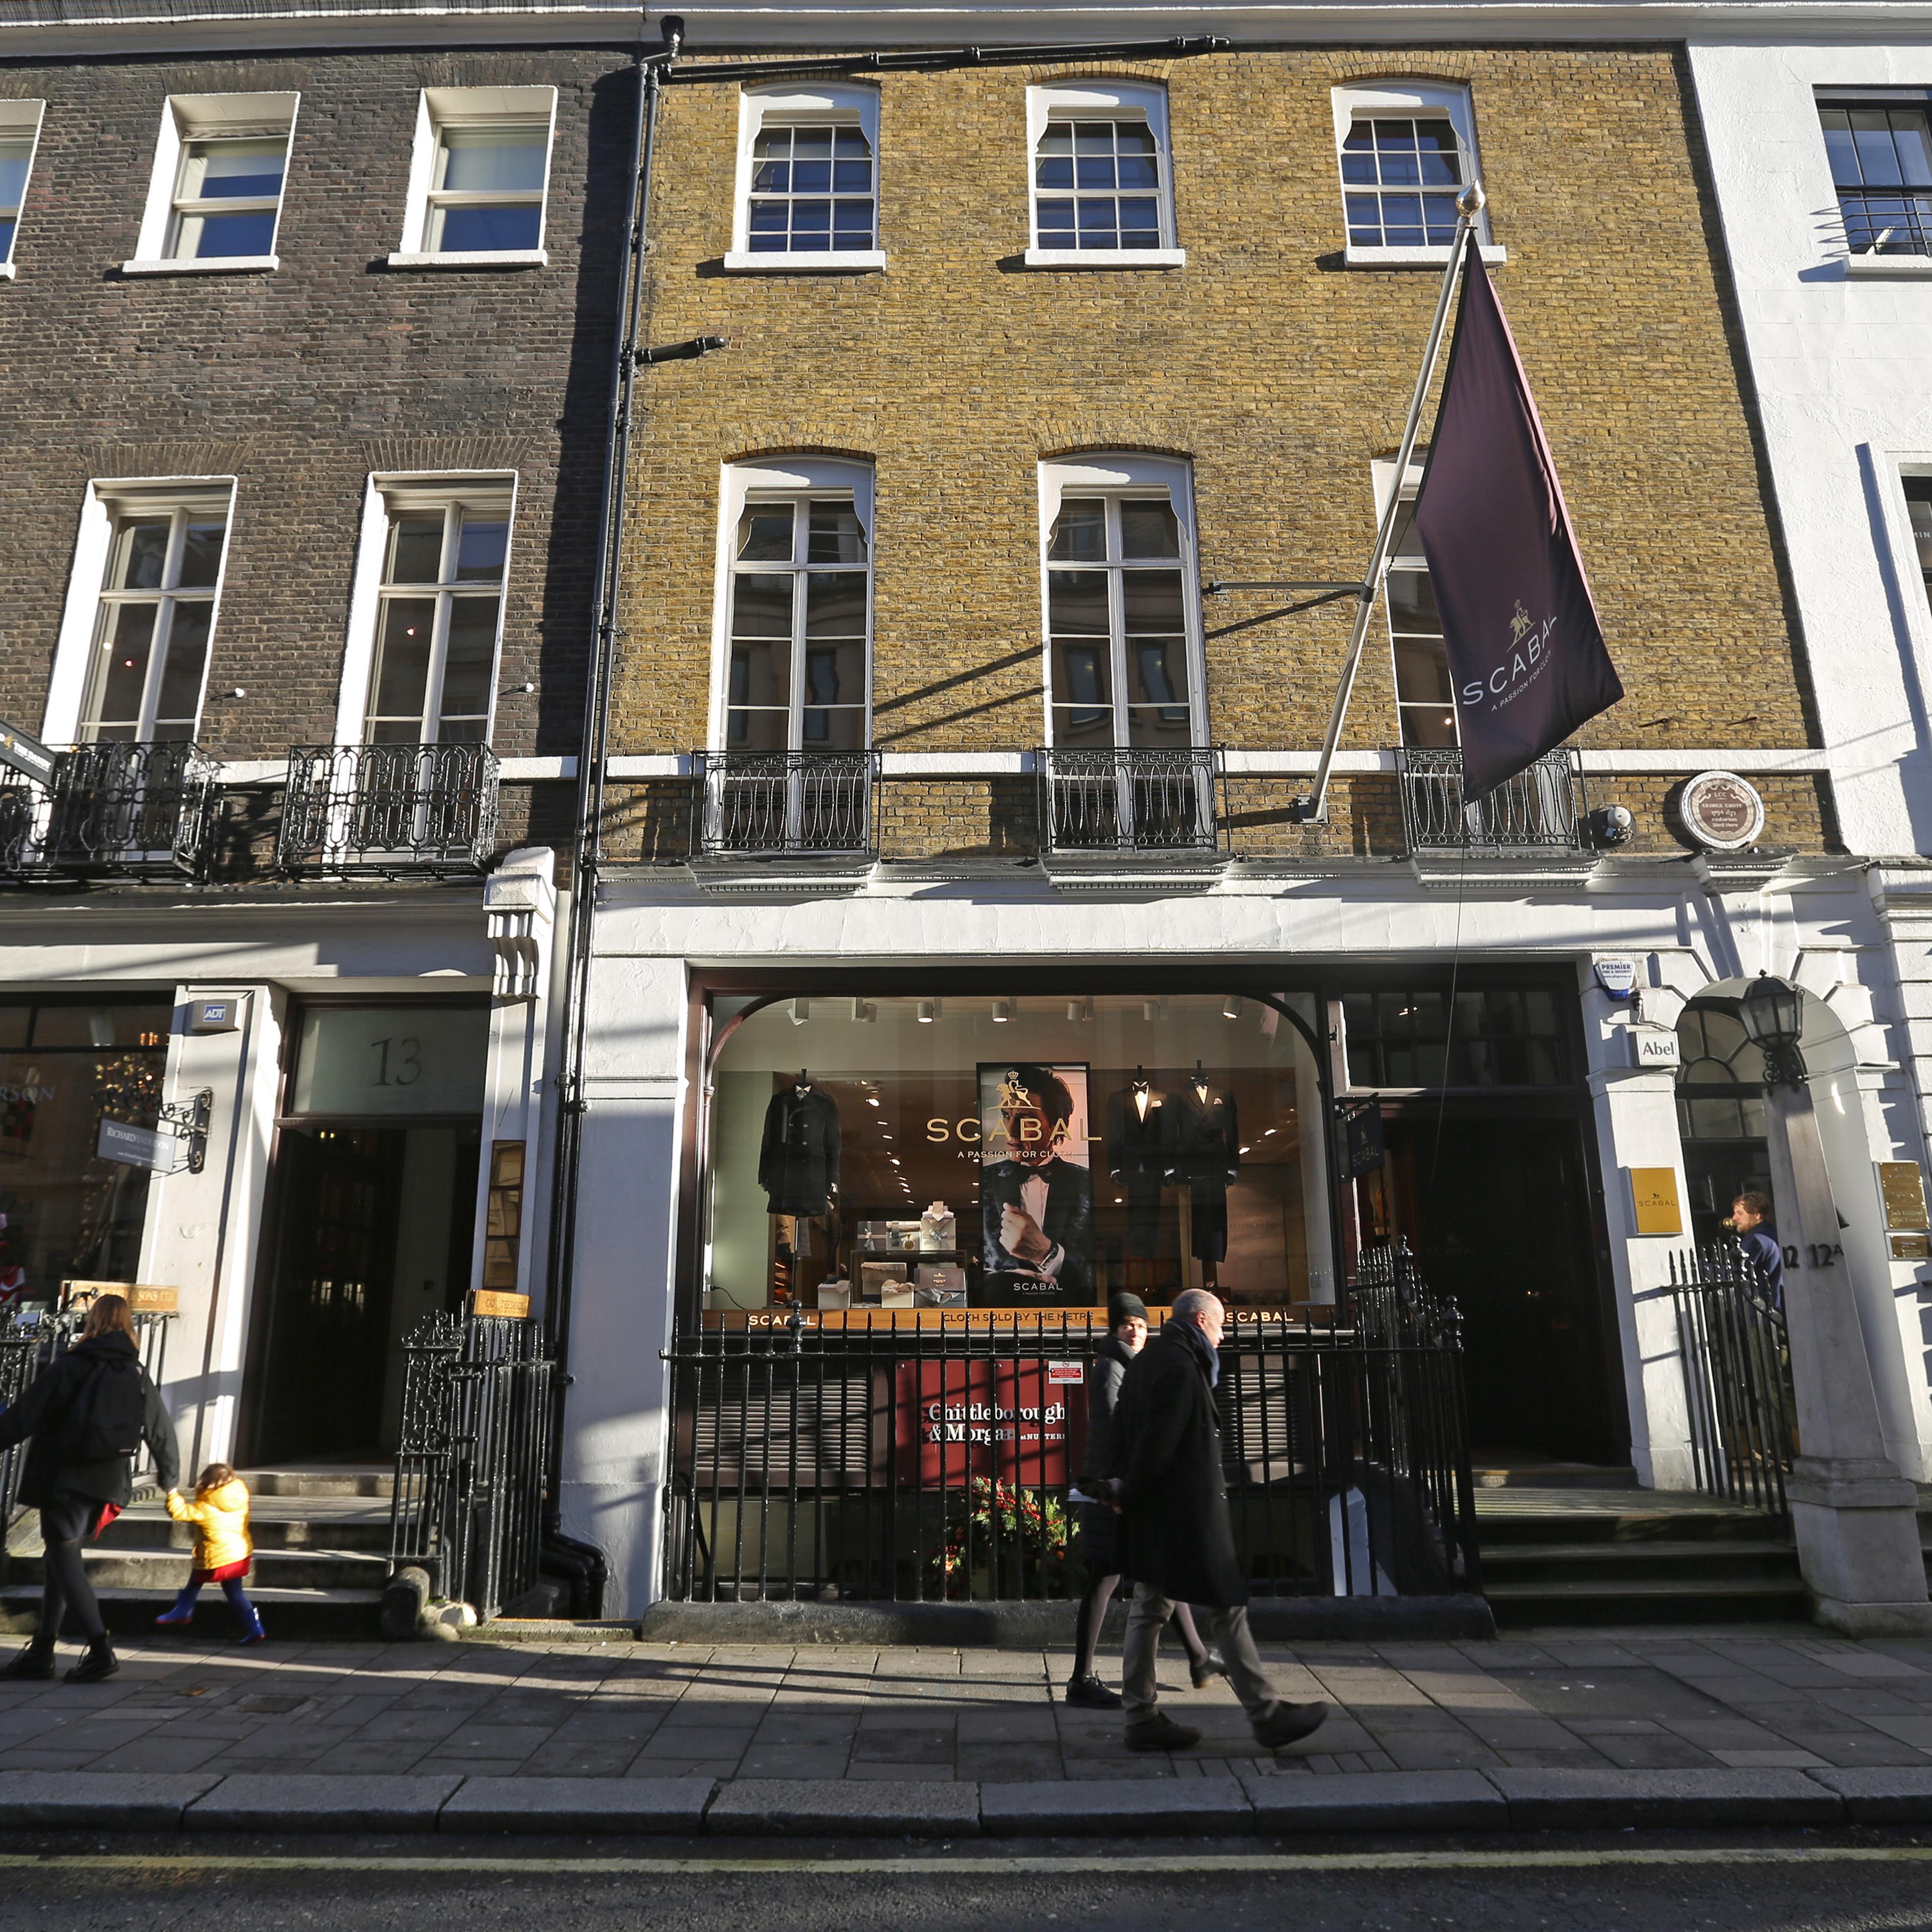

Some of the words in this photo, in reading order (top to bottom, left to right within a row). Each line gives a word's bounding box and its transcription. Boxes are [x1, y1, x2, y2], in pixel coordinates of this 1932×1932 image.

[1463, 615, 1557, 705] SCABAL
[1500, 681, 1528, 708] PASSION
[1530, 668, 1540, 683] FOR
[203, 1008, 225, 1018] ADT
[1643, 1041, 1674, 1055] Abel
[371, 1036, 423, 1086] 13
[926, 1117, 1102, 1142] SCABAL
[1353, 1144, 1379, 1167] SCABAL
[1782, 1245, 1800, 1269] 12
[137, 1291, 158, 1302] SONS
[749, 1315, 816, 1325] SCAL
[1226, 1312, 1294, 1322] SCABAL
[930, 1424, 941, 1441] &
